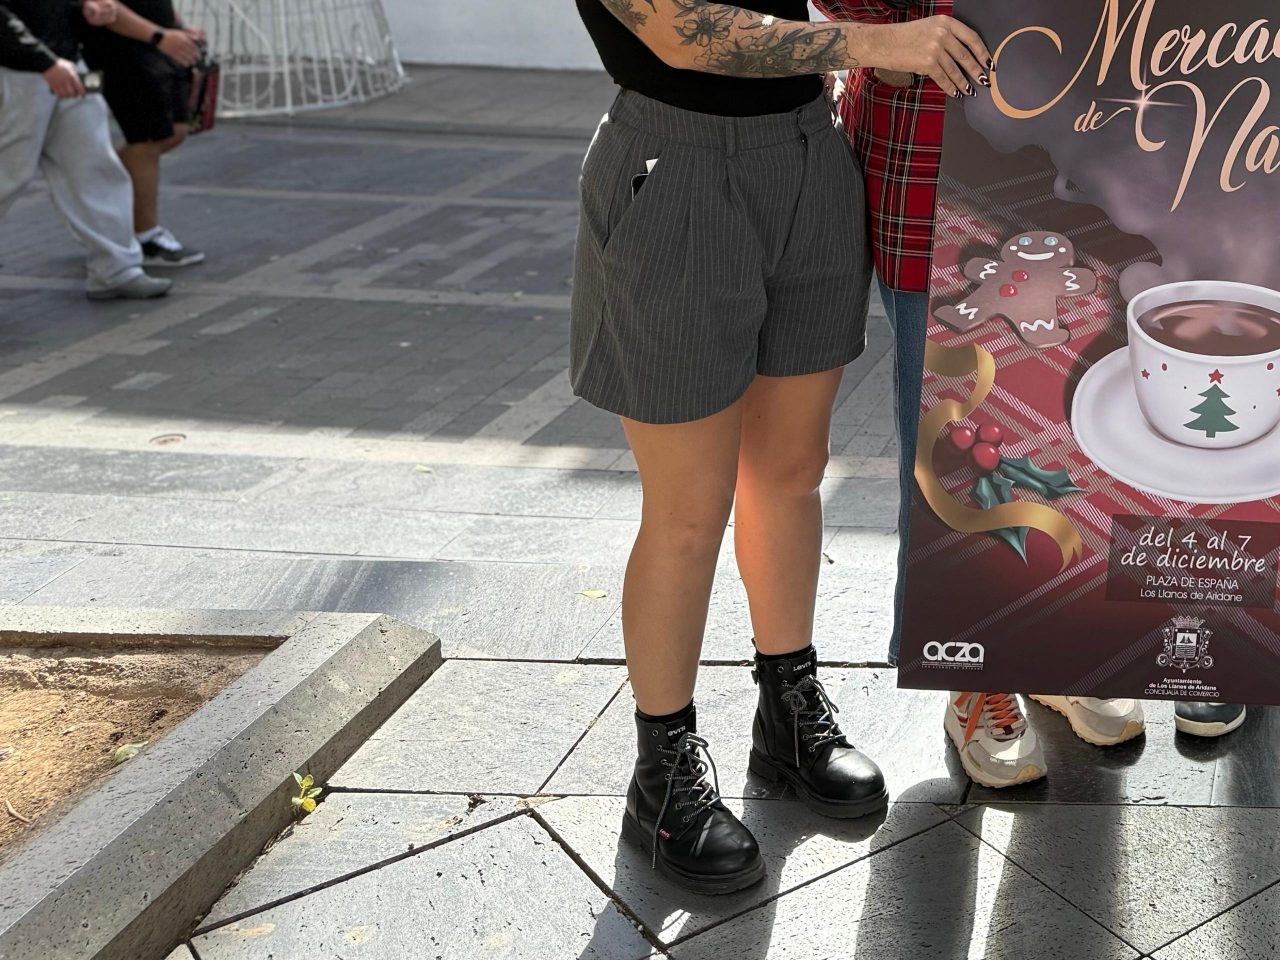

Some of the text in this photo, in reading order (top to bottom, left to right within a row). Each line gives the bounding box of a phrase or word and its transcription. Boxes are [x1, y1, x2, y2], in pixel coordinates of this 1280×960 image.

[1073, 101, 1131, 133] de
[1139, 526, 1252, 551] del 4 al 7
[1120, 545, 1266, 573] de diciembre
[1140, 588, 1243, 602] Los Llanos de Aridane
[1146, 575, 1240, 591] PLAZA DE ESPAÑA
